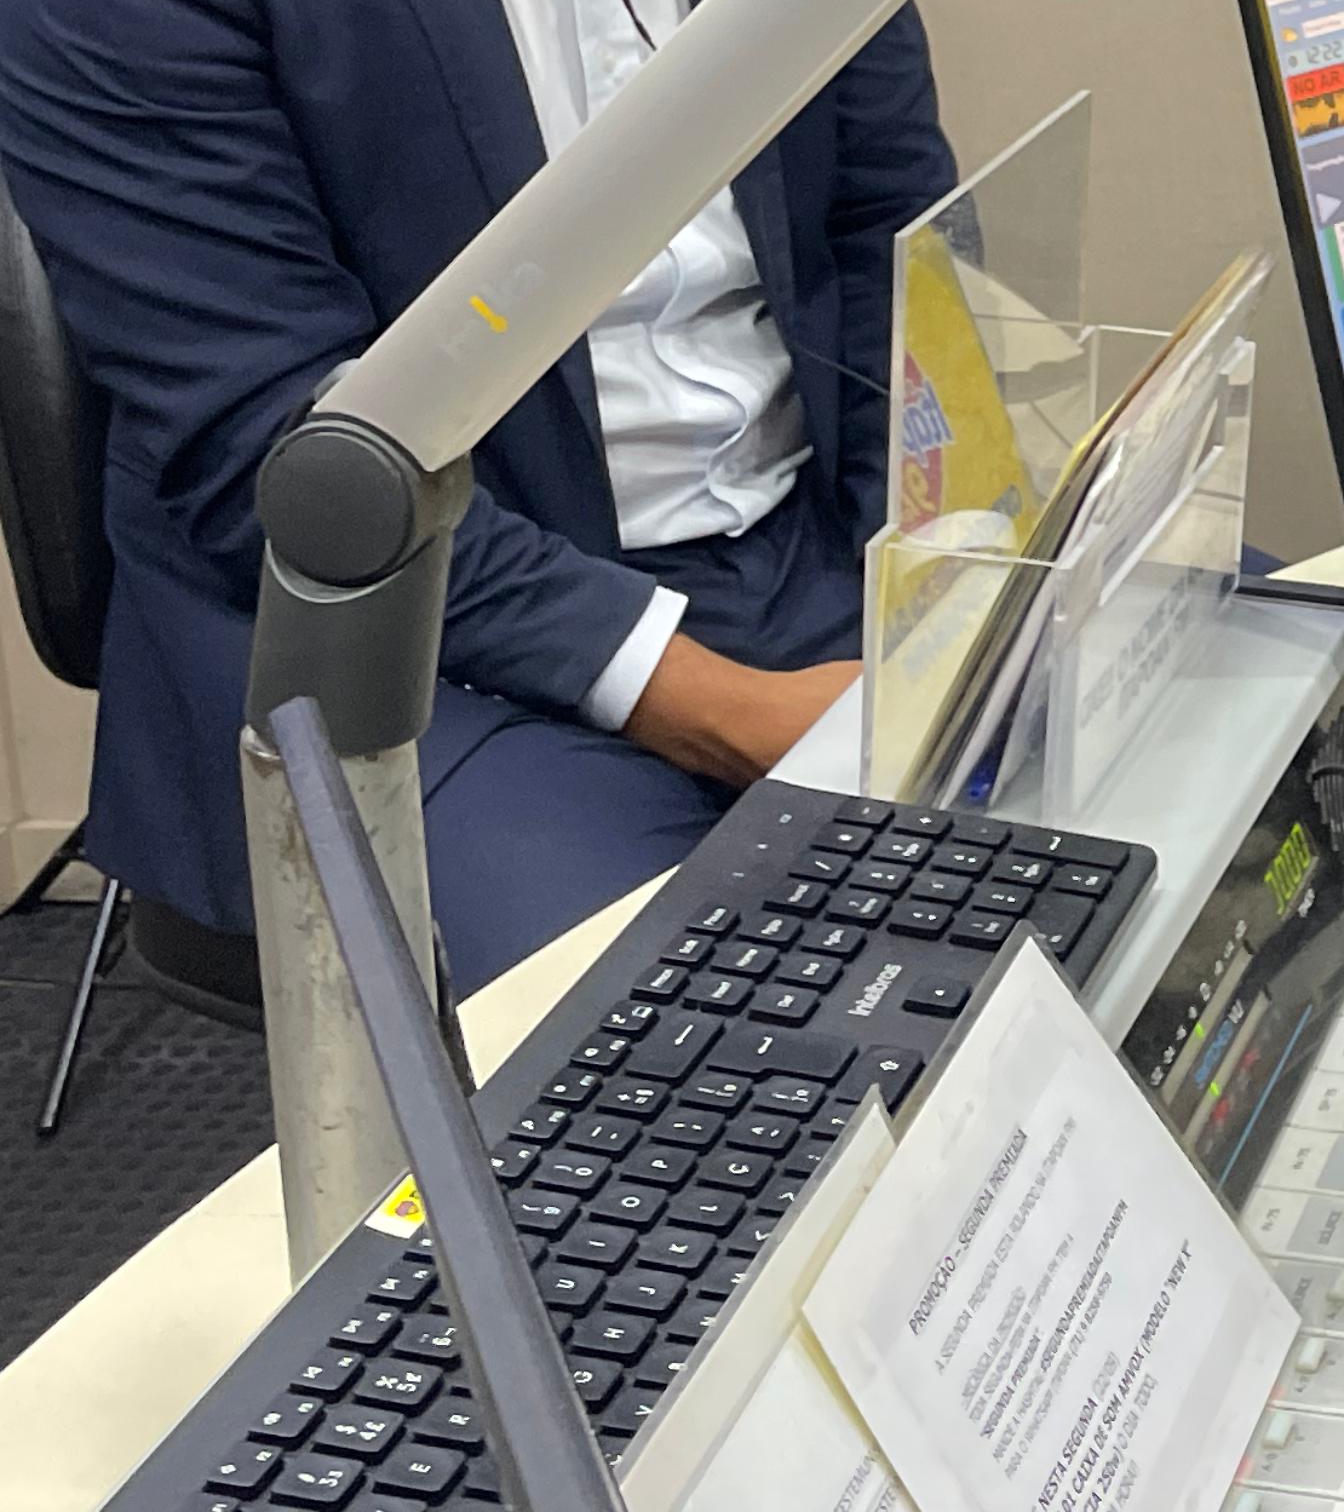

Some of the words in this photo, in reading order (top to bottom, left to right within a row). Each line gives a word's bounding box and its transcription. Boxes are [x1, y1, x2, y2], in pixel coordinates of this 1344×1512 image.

[1035, 1459, 1068, 1511] NESTA
[1058, 1396, 1100, 1464] SEGUNDA
[1069, 1445, 1101, 1495] CAIXA
